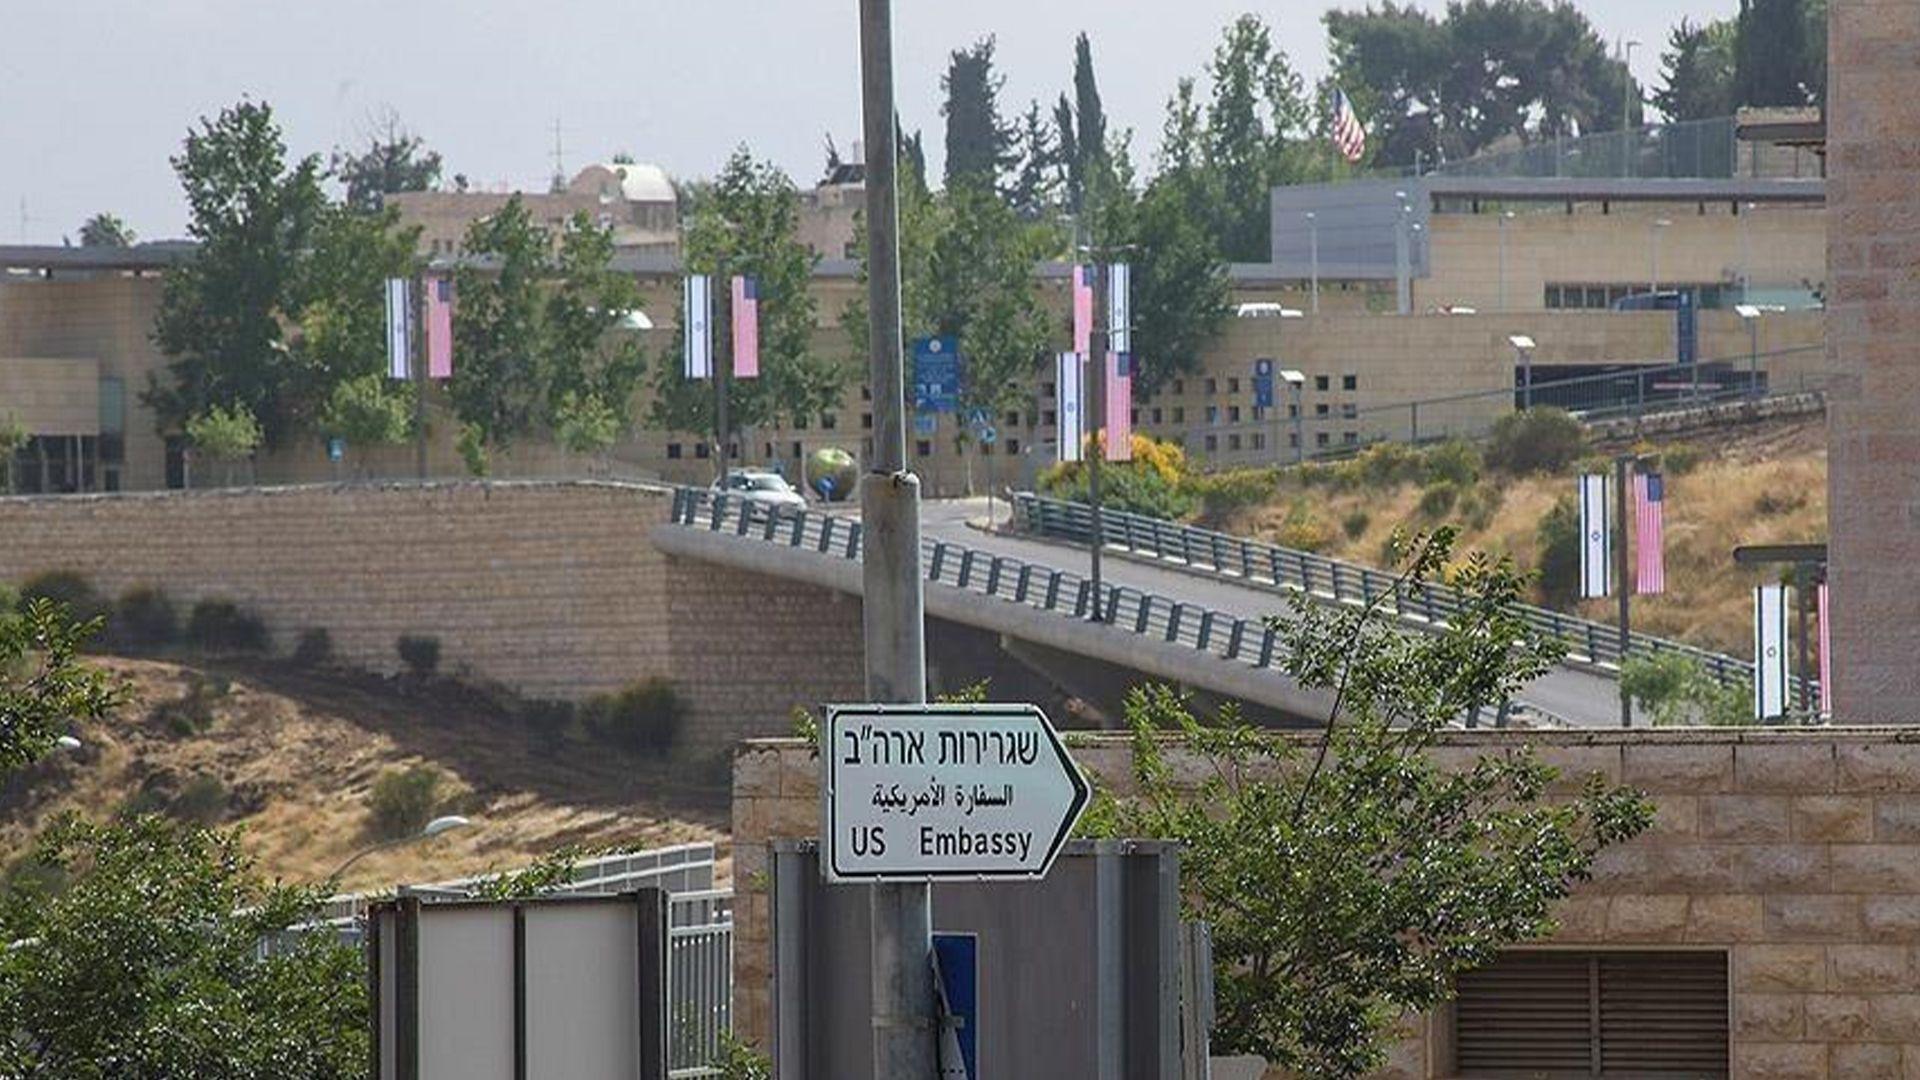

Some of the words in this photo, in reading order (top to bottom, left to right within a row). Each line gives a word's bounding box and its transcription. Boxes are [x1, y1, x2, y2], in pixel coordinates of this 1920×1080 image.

[939, 730, 1039, 765] שגרירות
[872, 777, 946, 816] الأمريكية
[955, 784, 1013, 816] السفارة
[851, 826, 886, 857] US
[920, 826, 1032, 862] Embassy
